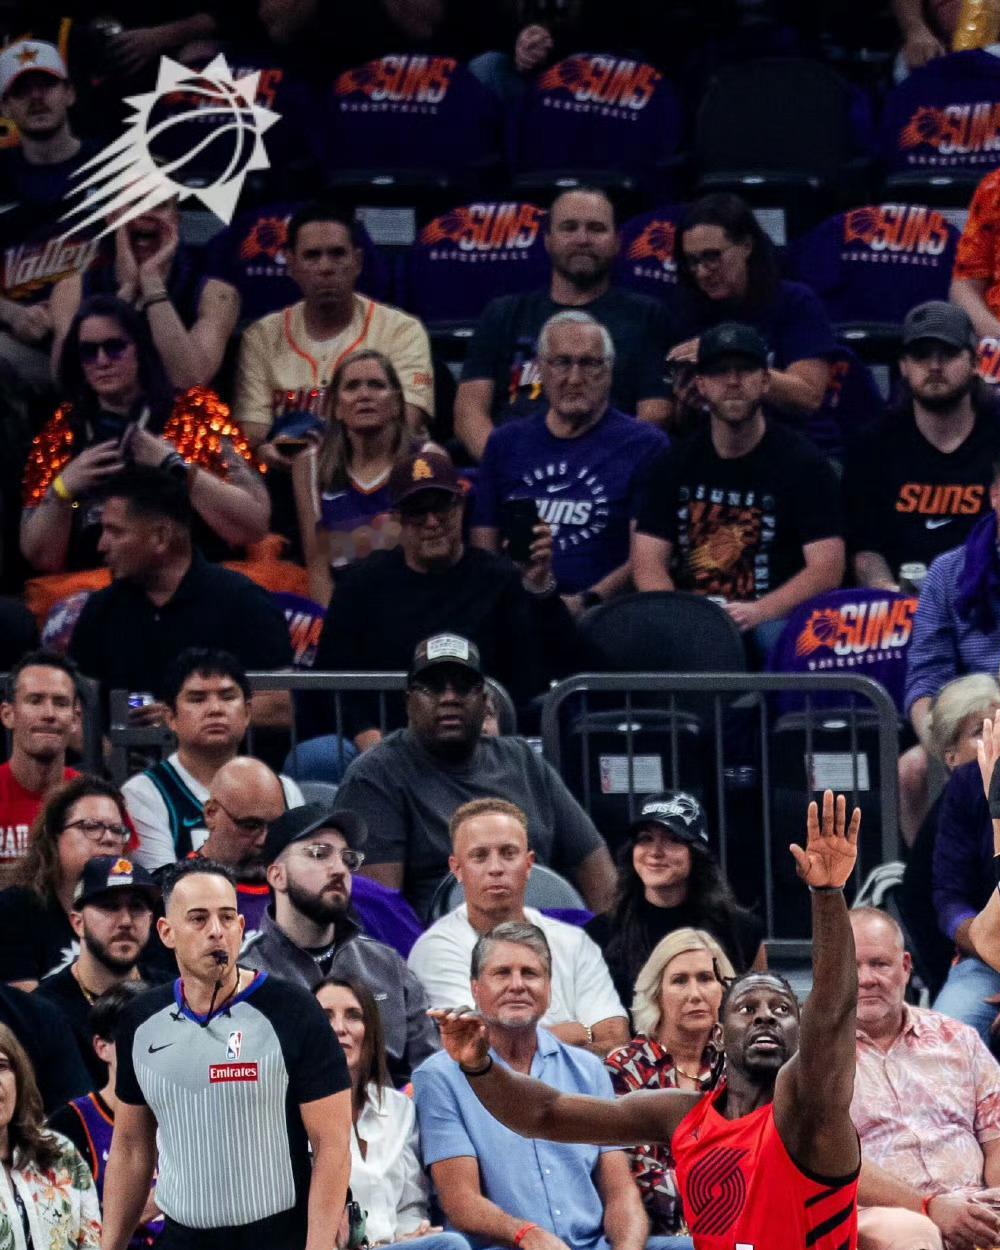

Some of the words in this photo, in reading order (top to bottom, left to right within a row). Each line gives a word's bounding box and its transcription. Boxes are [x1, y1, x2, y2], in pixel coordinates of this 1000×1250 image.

[371, 55, 457, 102] SUNS
[575, 56, 662, 109] SUNS
[460, 202, 547, 251] SUNS
[870, 204, 949, 256] SUNS
[895, 484, 985, 516] SUNS
[833, 597, 919, 656] SUNS
[210, 1066, 257, 1079] Emirates
